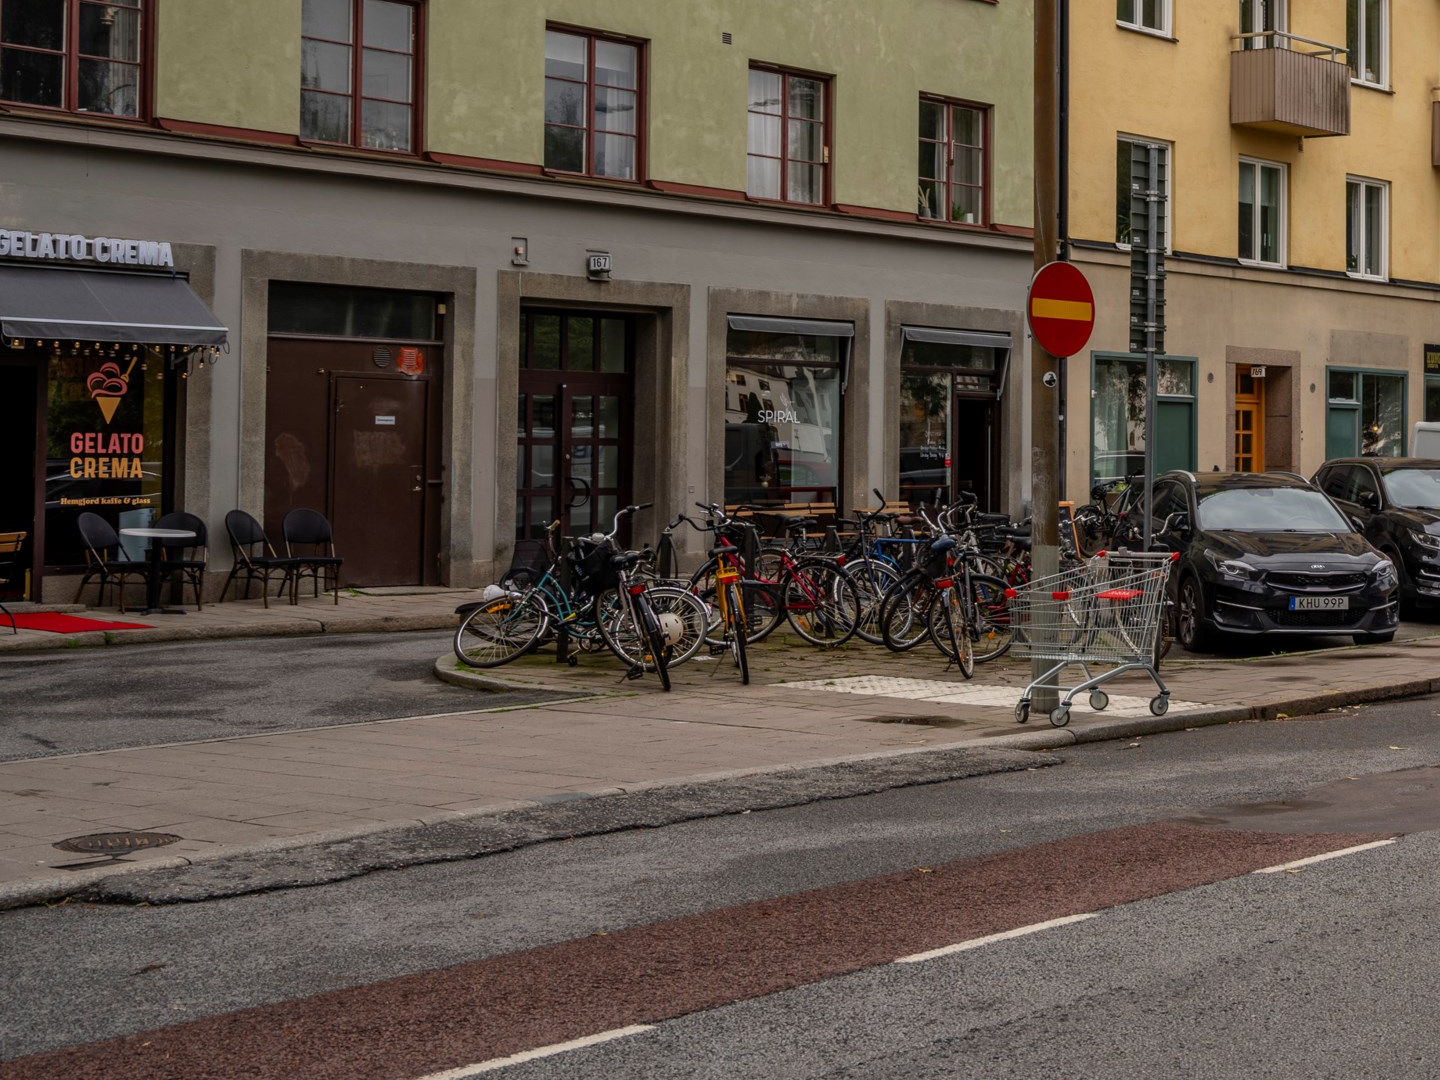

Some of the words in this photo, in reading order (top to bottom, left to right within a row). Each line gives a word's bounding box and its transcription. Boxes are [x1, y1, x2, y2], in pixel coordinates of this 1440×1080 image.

[0, 229, 87, 260] GELATO
[94, 237, 174, 267] CREMA
[592, 257, 607, 268] 167
[757, 410, 801, 424] SPIRAL
[70, 432, 144, 454] GELATO
[70, 457, 143, 479] CREMA
[60, 497, 99, 506] Hemgjord
[101, 497, 122, 505] kaffe
[123, 497, 131, 505] &
[132, 497, 151, 505] glass
[1299, 597, 1320, 609] KHU
[1323, 597, 1344, 609] 99P
